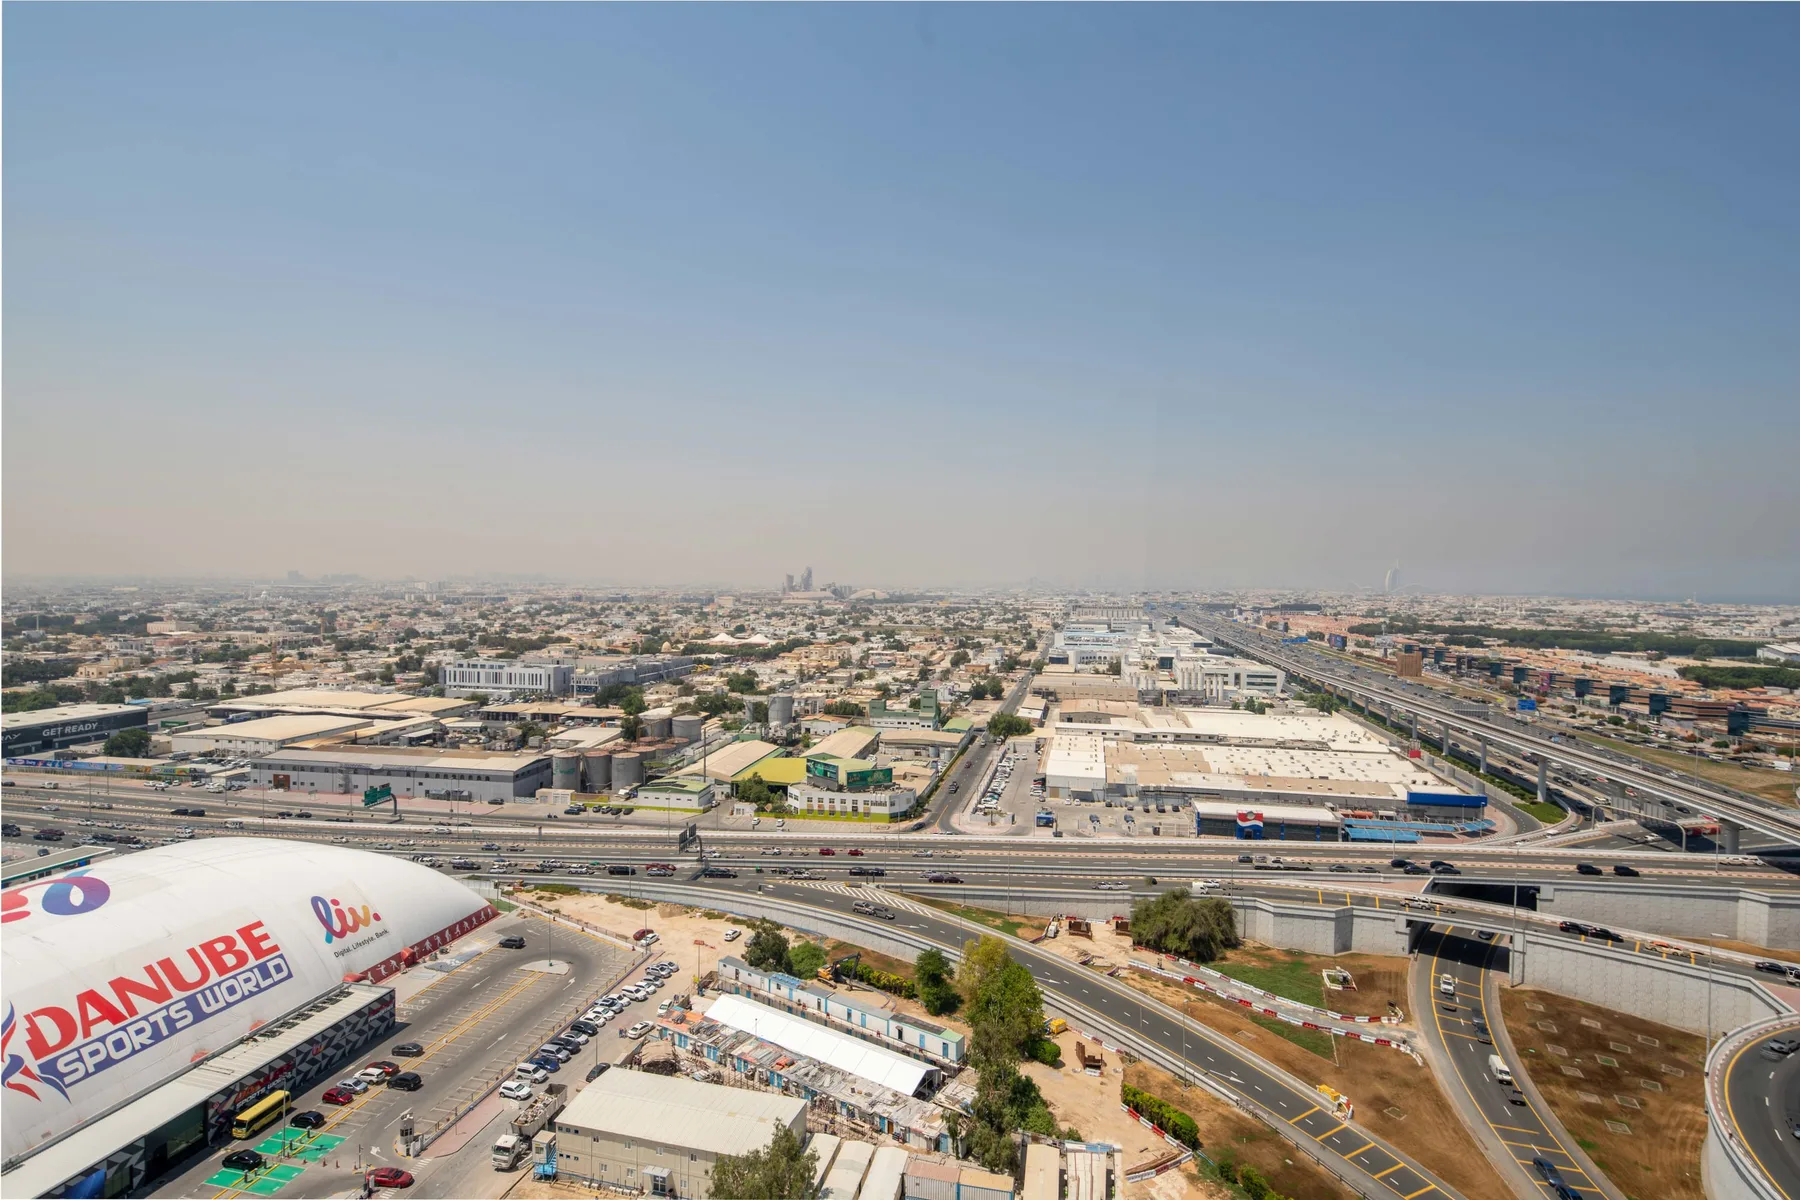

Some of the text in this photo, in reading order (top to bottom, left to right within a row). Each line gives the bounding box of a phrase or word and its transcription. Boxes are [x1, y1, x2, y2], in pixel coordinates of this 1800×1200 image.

[42, 722, 98, 737] GET READY
[24, 920, 281, 1061] DANUBE
[56, 957, 290, 1086] SPORTS WORLD
